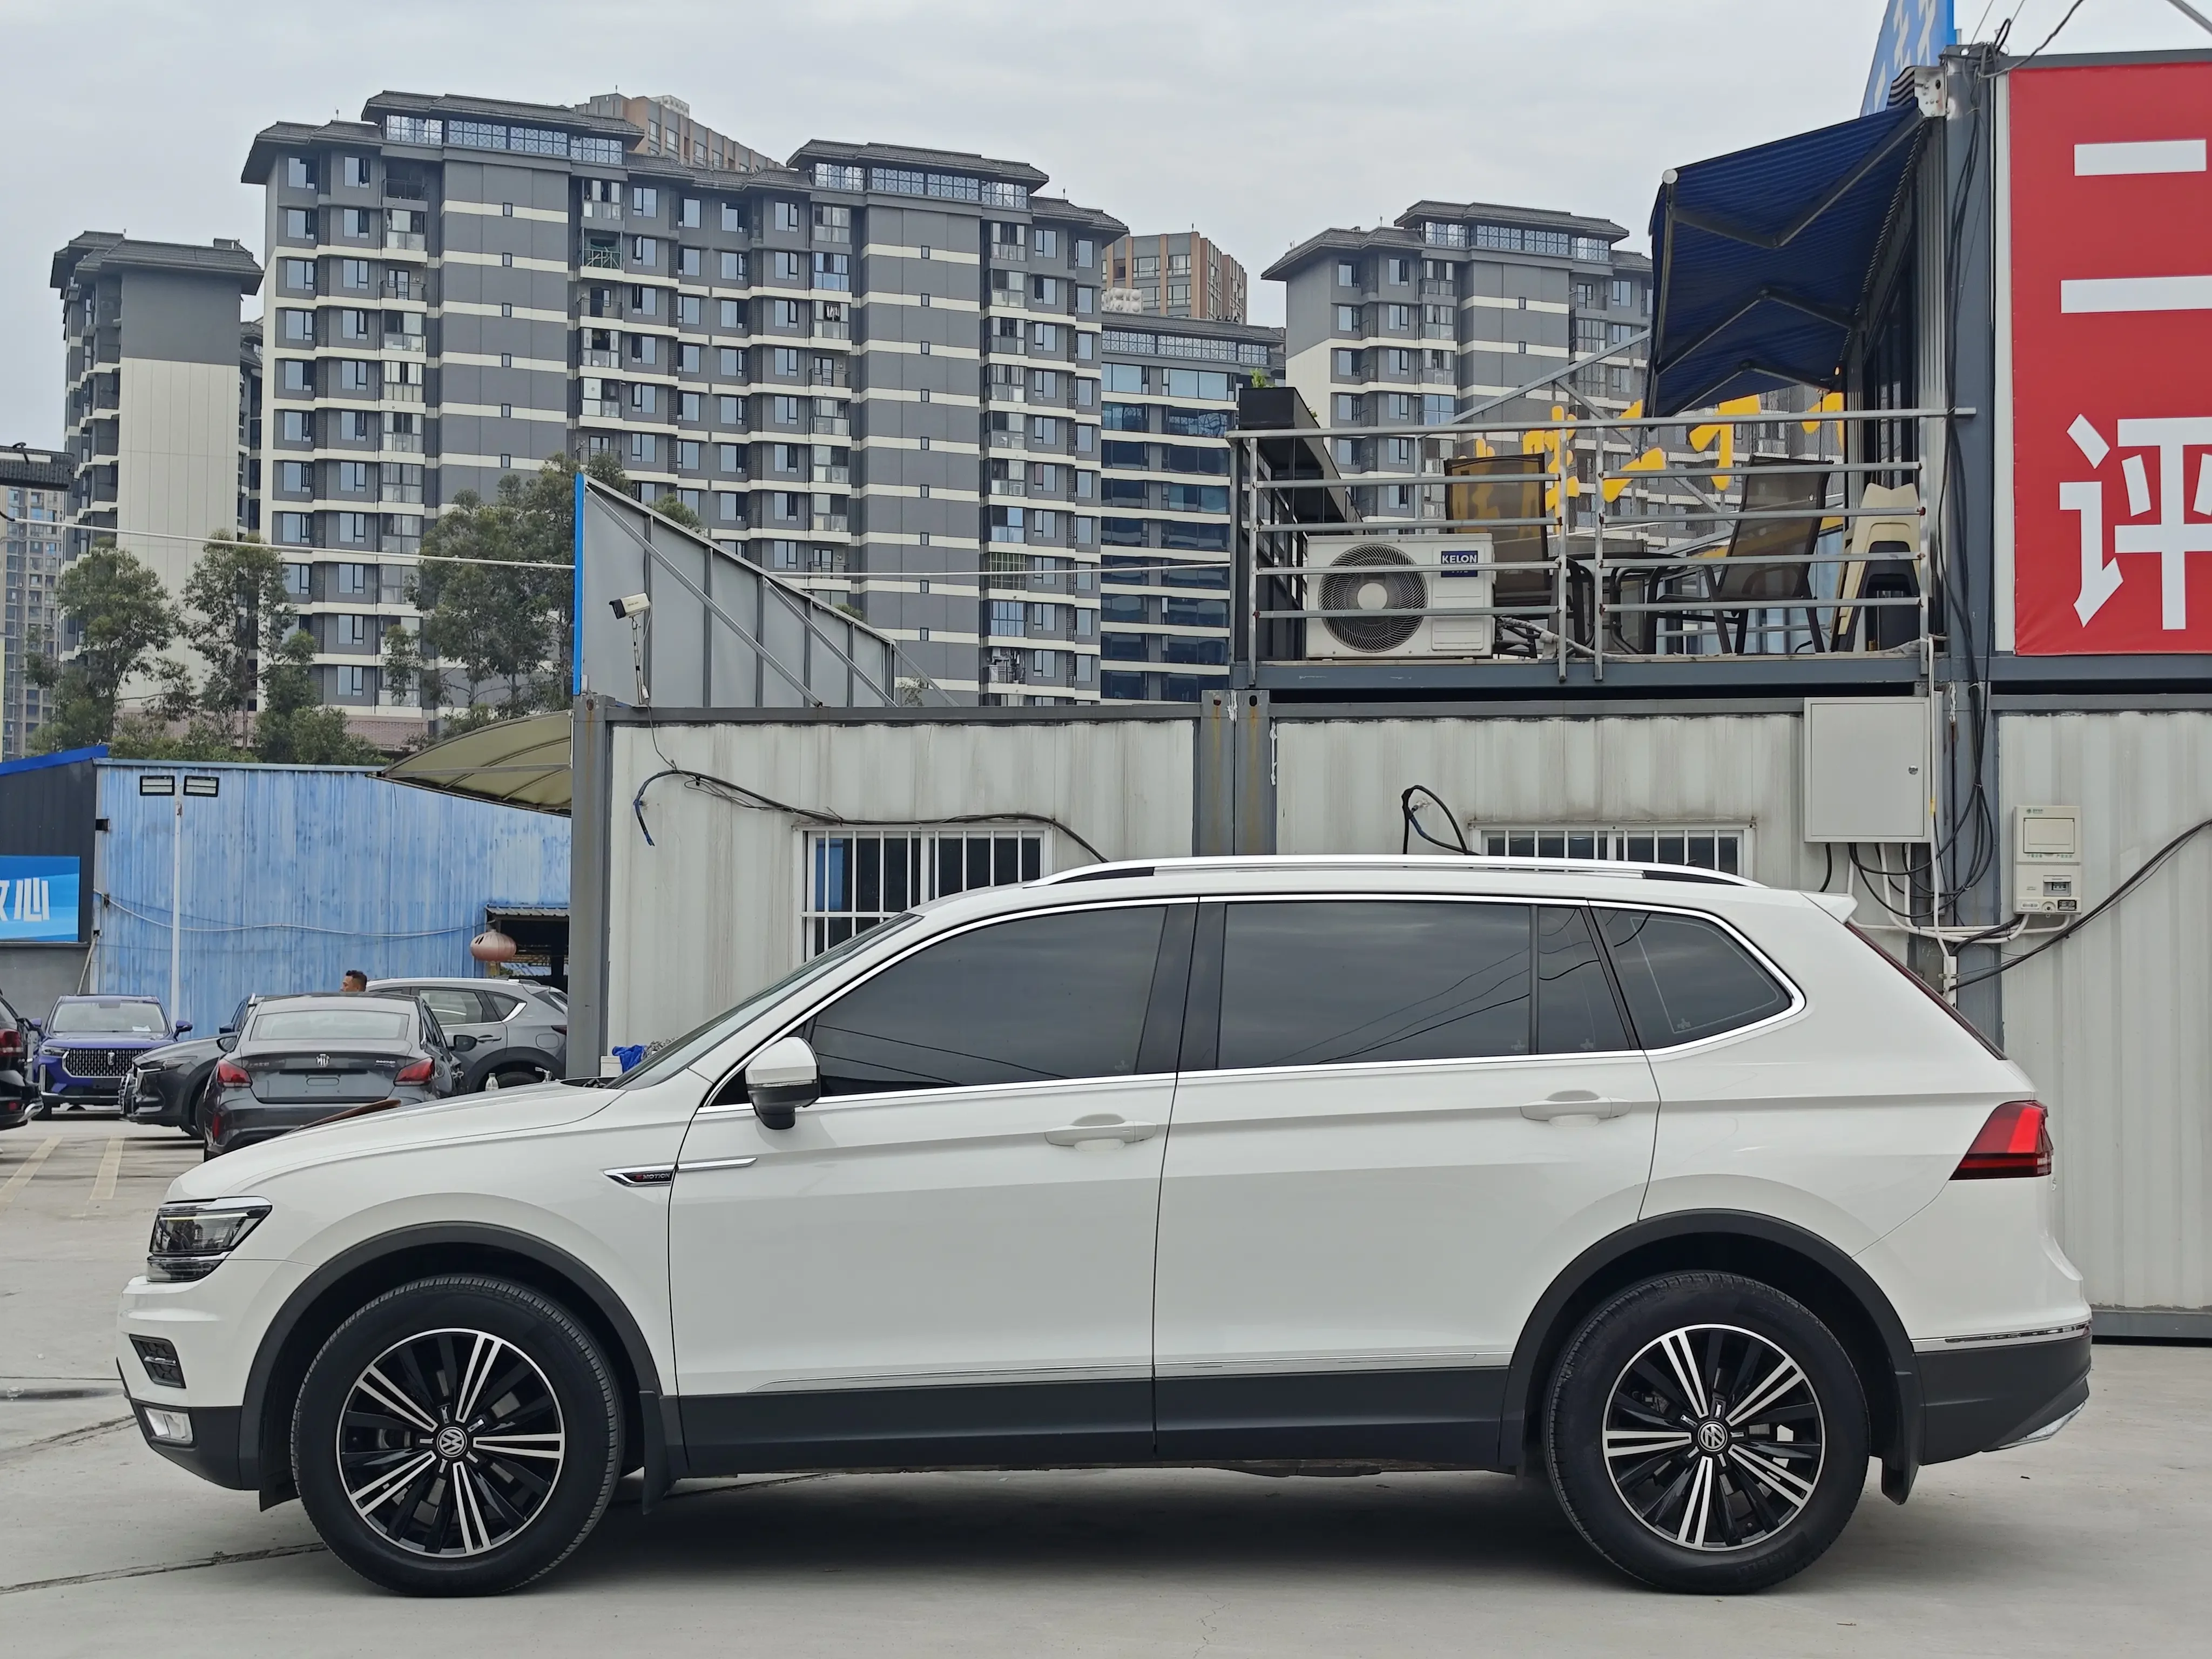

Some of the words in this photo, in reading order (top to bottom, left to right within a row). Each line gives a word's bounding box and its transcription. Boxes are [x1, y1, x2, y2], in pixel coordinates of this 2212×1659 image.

[2059, 413, 2212, 630] 评
[1442, 555, 1477, 564] KELON
[0, 876, 50, 922] 心
